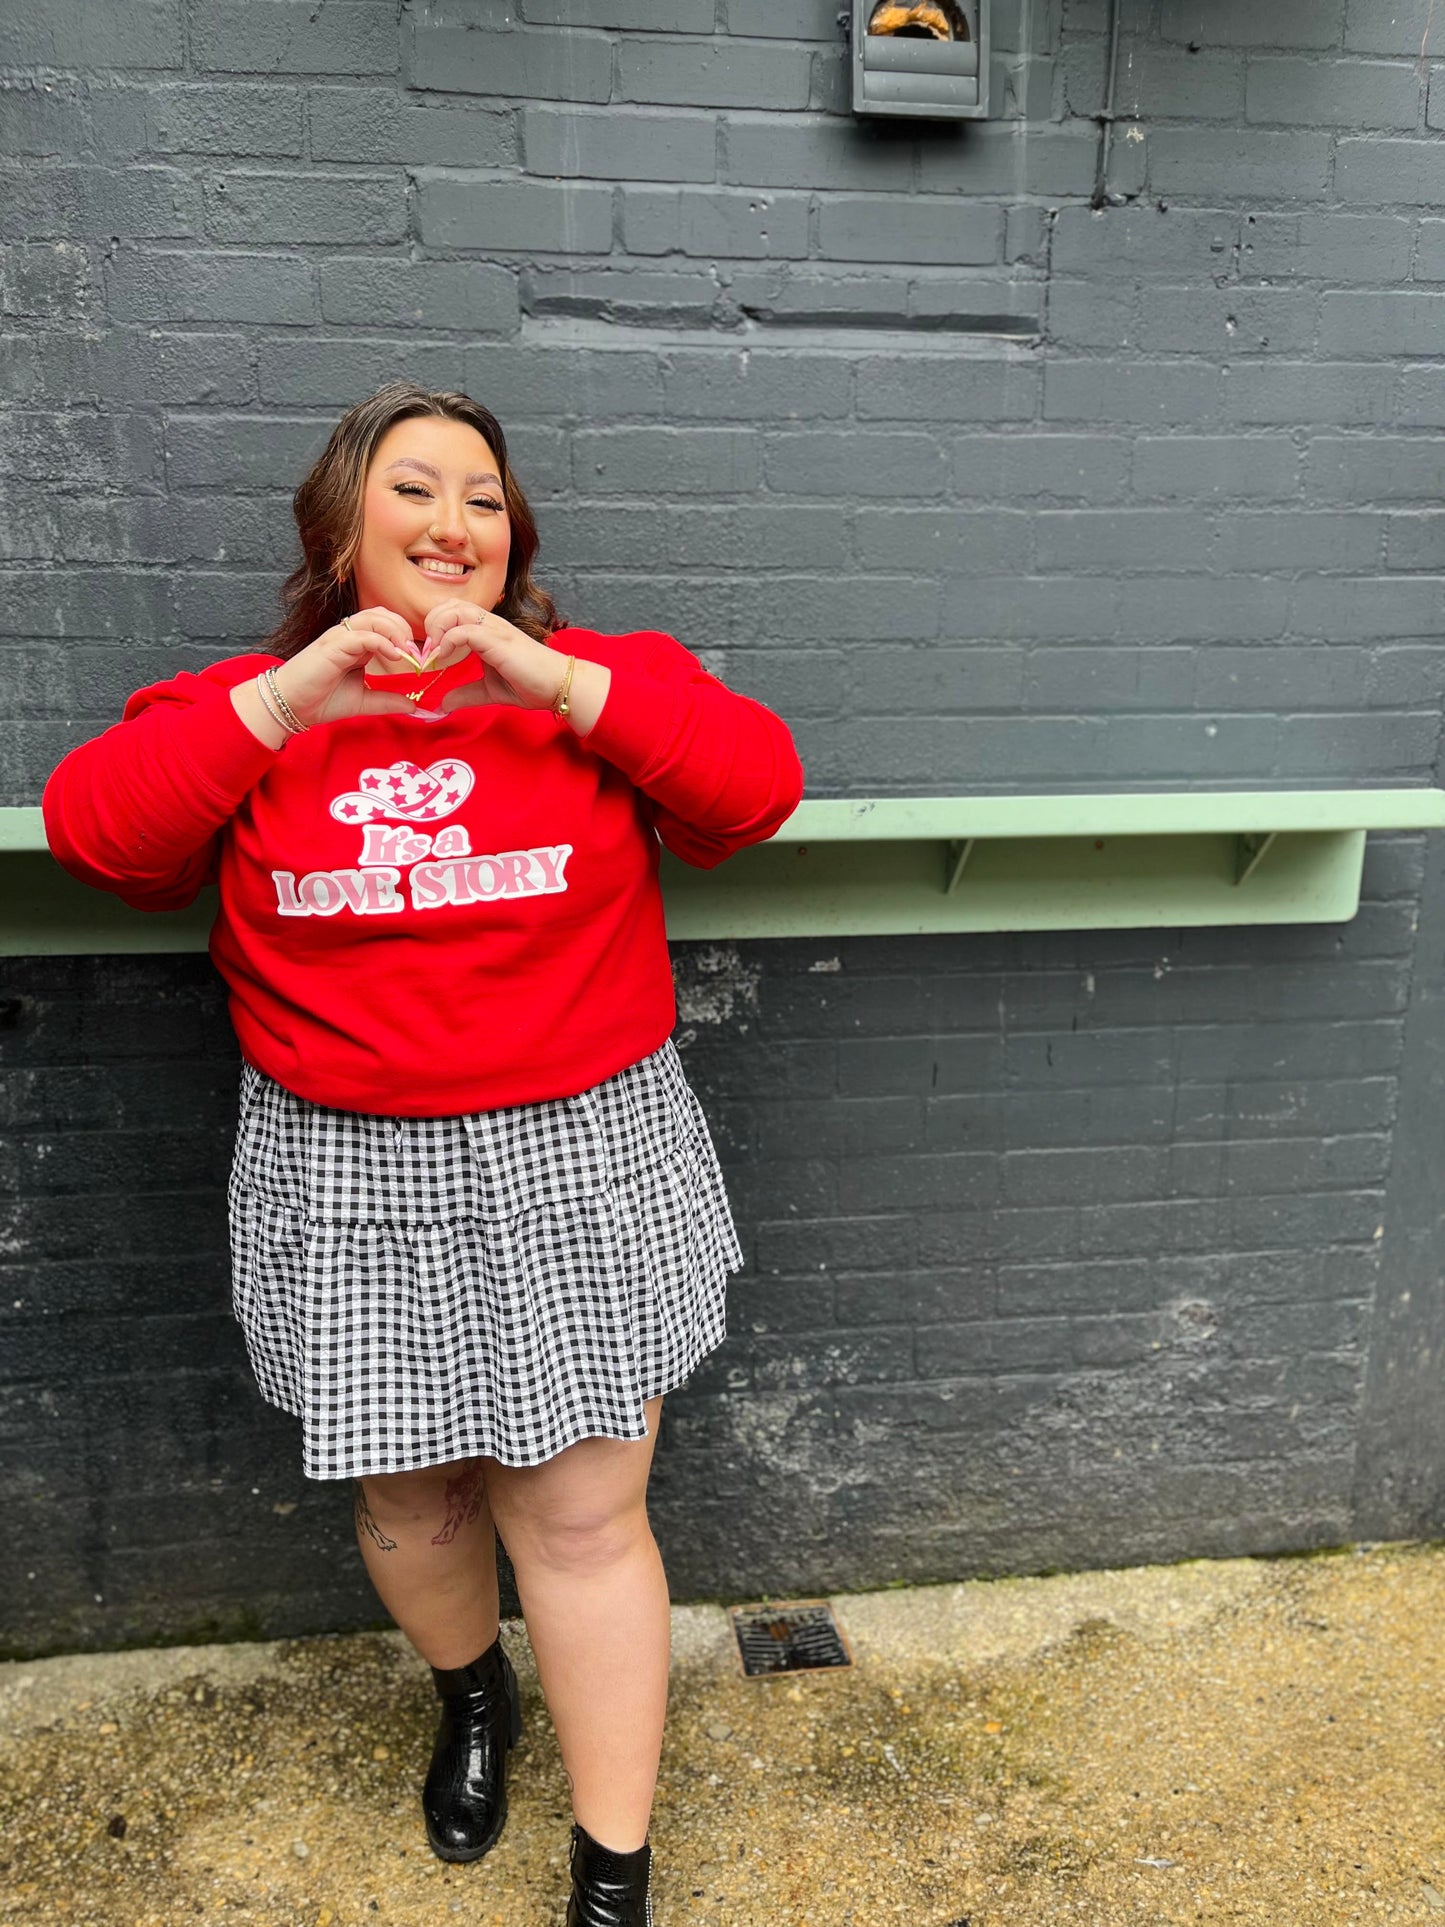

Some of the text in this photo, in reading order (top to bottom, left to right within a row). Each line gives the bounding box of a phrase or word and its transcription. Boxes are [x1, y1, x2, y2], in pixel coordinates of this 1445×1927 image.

[363, 828, 466, 864] It's a
[275, 849, 566, 912] LOVE STORY
